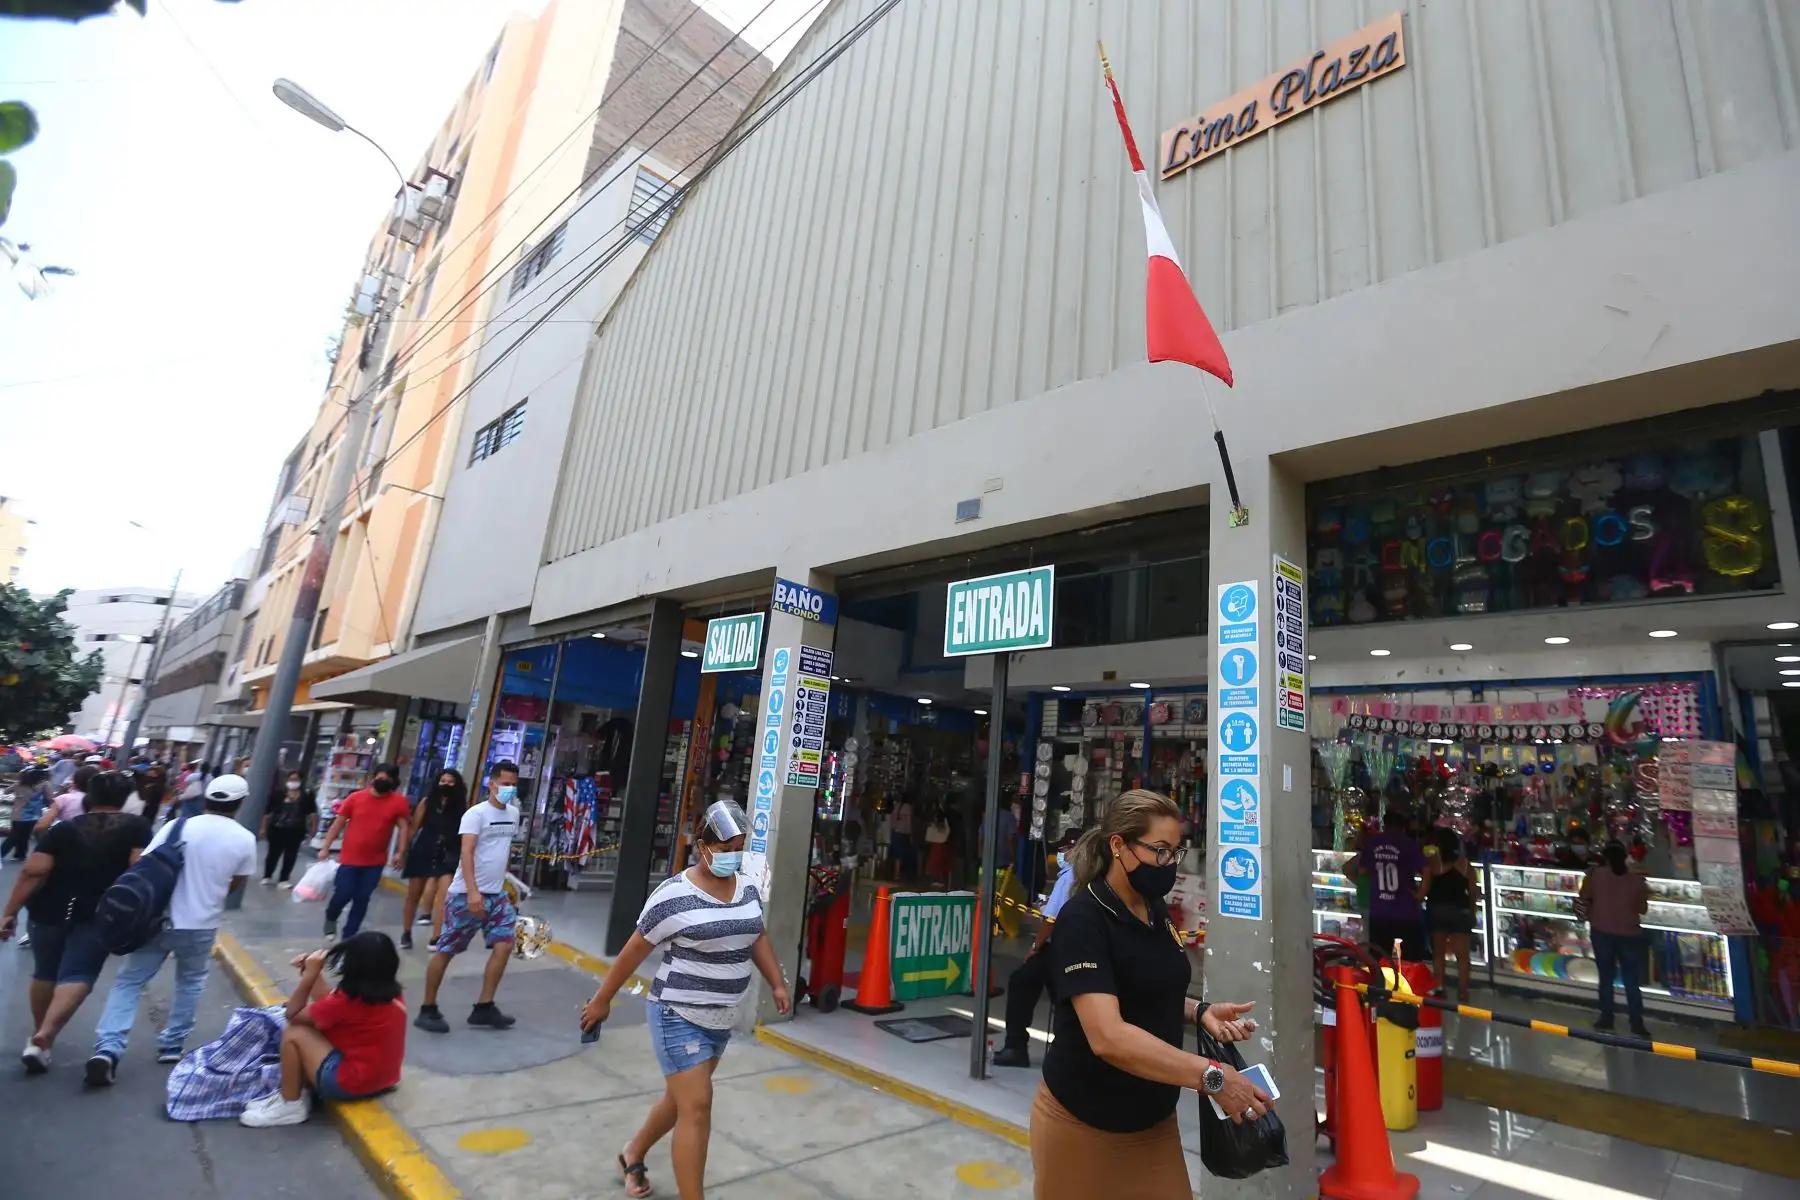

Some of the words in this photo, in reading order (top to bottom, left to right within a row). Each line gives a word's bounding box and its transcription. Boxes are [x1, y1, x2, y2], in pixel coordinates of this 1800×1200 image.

[1162, 100, 1260, 174] Lima
[1269, 30, 1400, 118] Plaza
[772, 602, 786, 612] AL
[788, 606, 821, 621] FONDO
[775, 583, 823, 613] BAÑO
[952, 579, 1044, 645] ENTRADA
[709, 621, 755, 665] SALIDA
[1375, 863, 1398, 891] 10
[895, 904, 971, 958] ENTRADA
